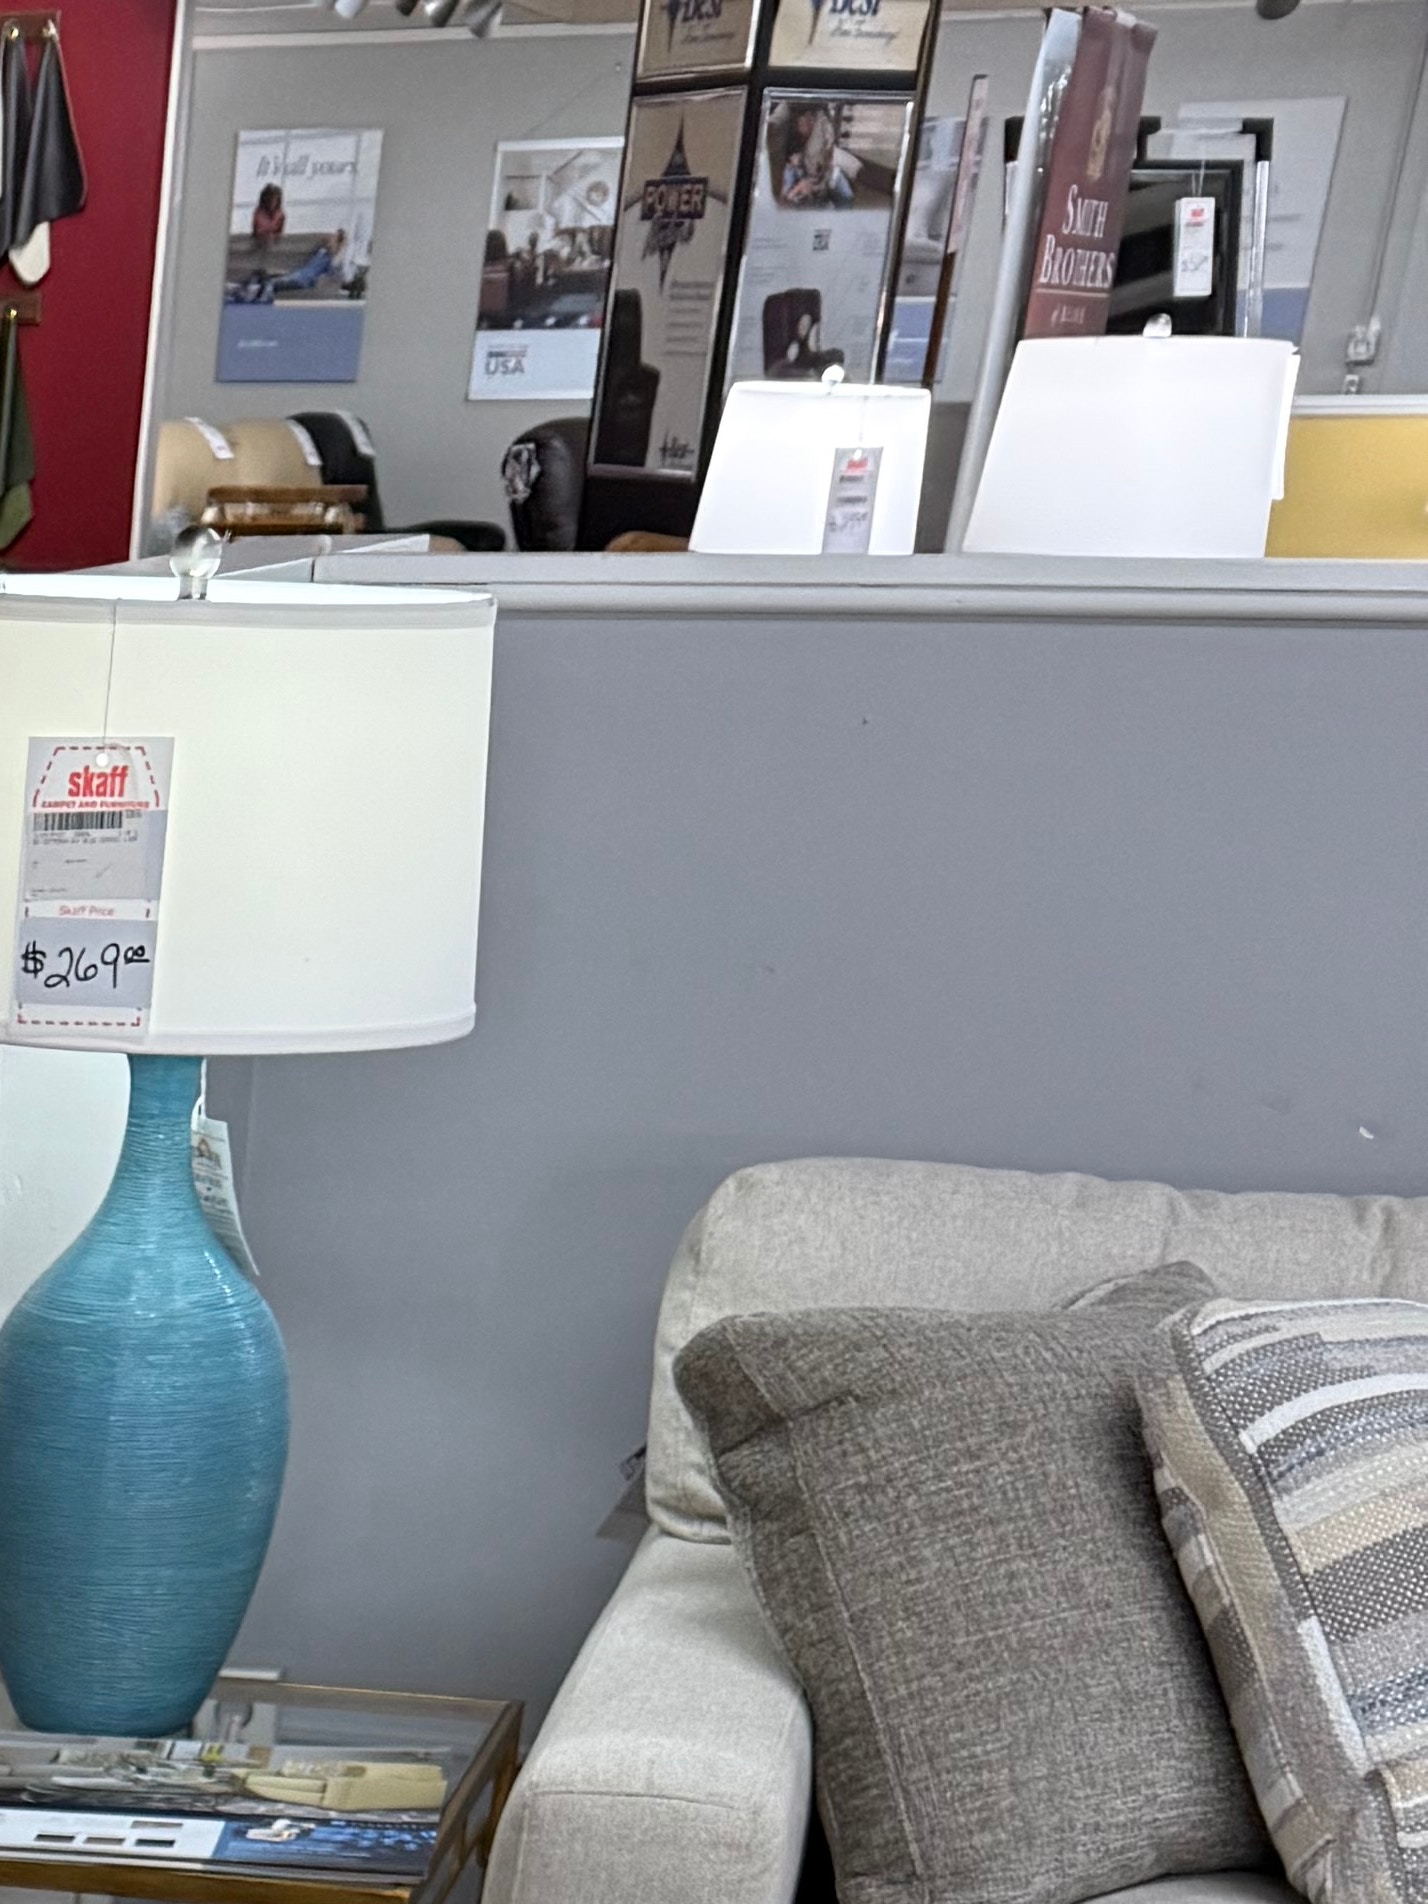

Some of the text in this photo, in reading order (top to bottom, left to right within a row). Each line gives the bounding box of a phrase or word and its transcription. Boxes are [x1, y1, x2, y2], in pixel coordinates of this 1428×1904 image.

[1062, 184, 1108, 238] SMITH
[1040, 234, 1115, 288] BROTHERS
[485, 358, 525, 376] USA
[68, 765, 129, 798] skaff
